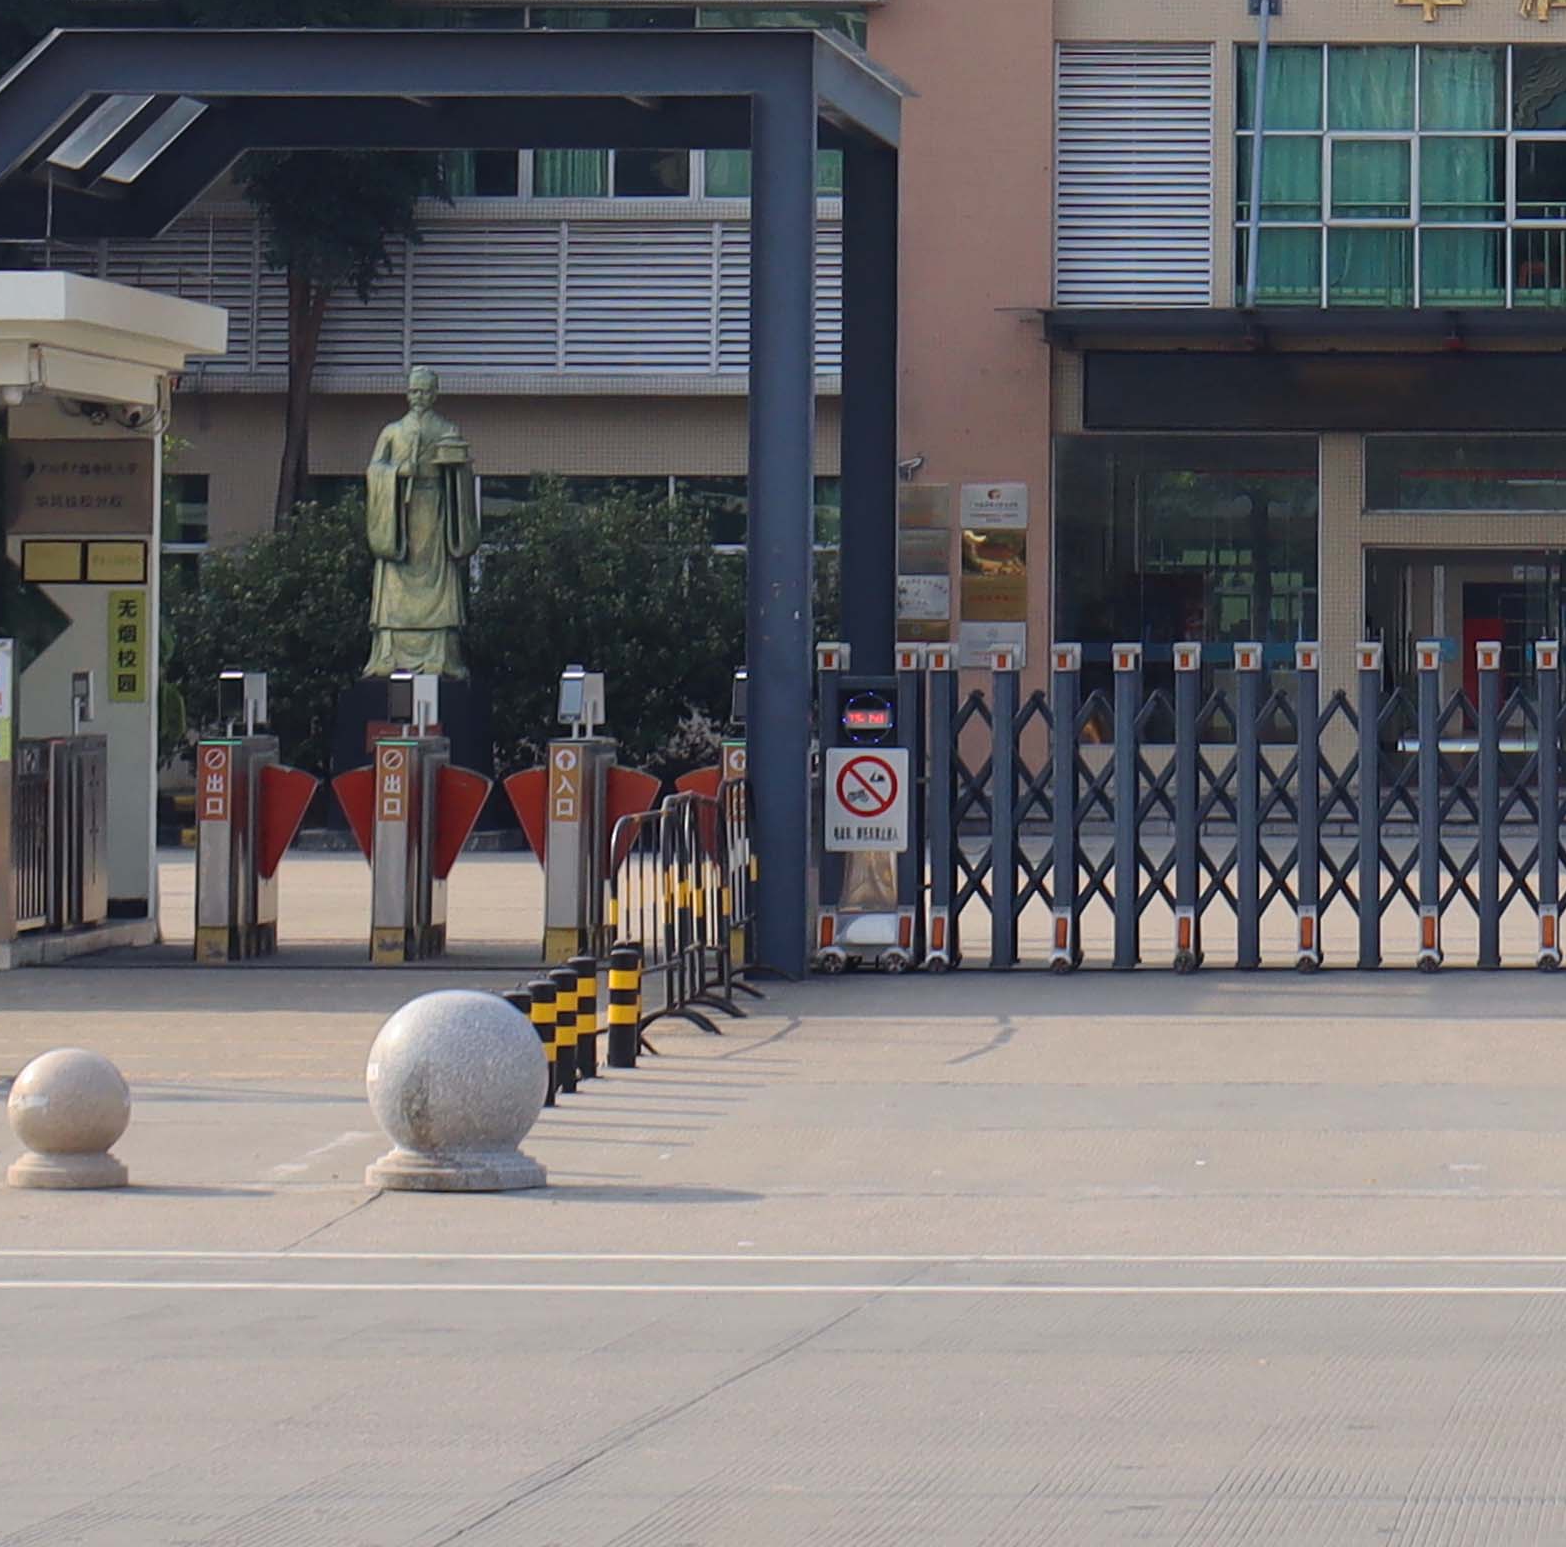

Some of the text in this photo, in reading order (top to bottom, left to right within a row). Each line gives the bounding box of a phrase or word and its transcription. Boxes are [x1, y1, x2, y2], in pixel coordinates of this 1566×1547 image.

[117, 599, 138, 693] 无烟校园
[205, 773, 224, 815] 出口
[383, 773, 402, 816] 出口
[555, 776, 574, 816] 入口
